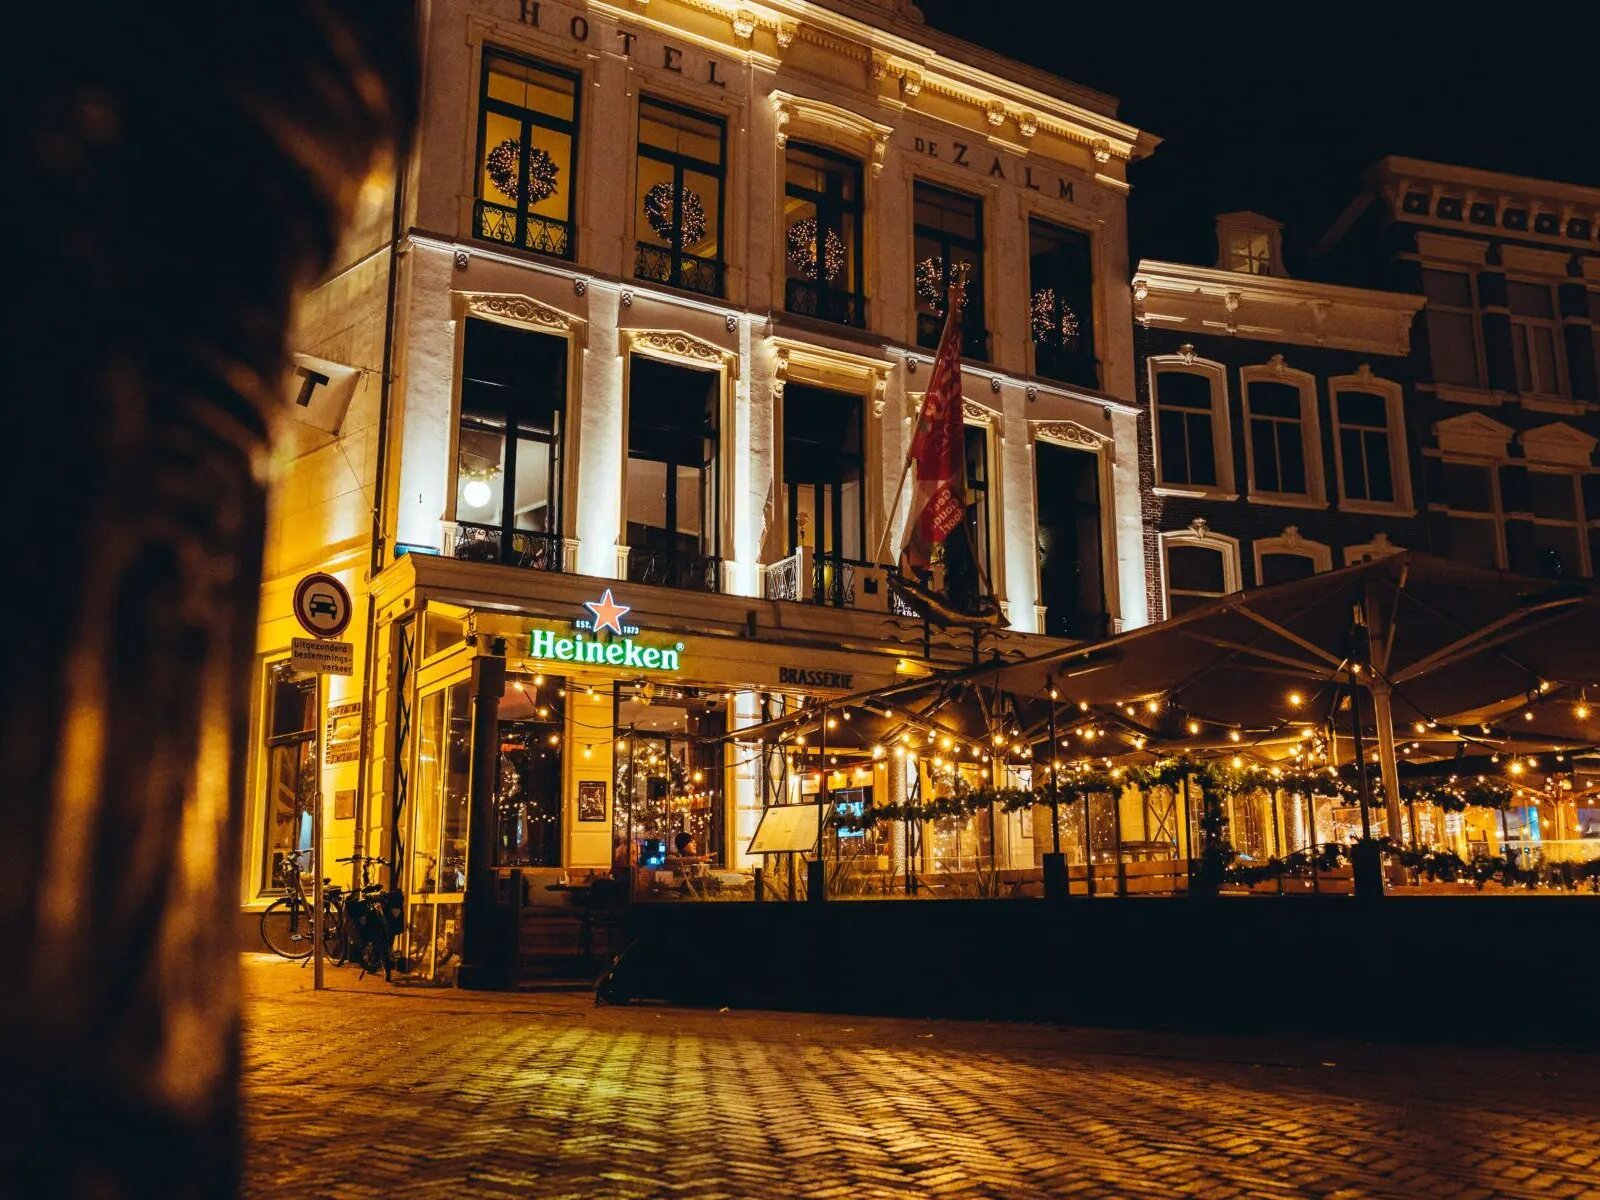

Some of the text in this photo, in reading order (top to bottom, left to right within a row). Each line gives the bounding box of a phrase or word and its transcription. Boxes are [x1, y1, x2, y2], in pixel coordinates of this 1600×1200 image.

[518, 0, 726, 88] HOTEL
[914, 136, 1075, 202] DE ZALM
[575, 619, 640, 636] EST. 1873
[294, 641, 347, 653] uitgezonderd
[294, 651, 352, 664] bestemmings-
[322, 664, 352, 673] verkeer
[778, 666, 853, 690] BRASSERIE
